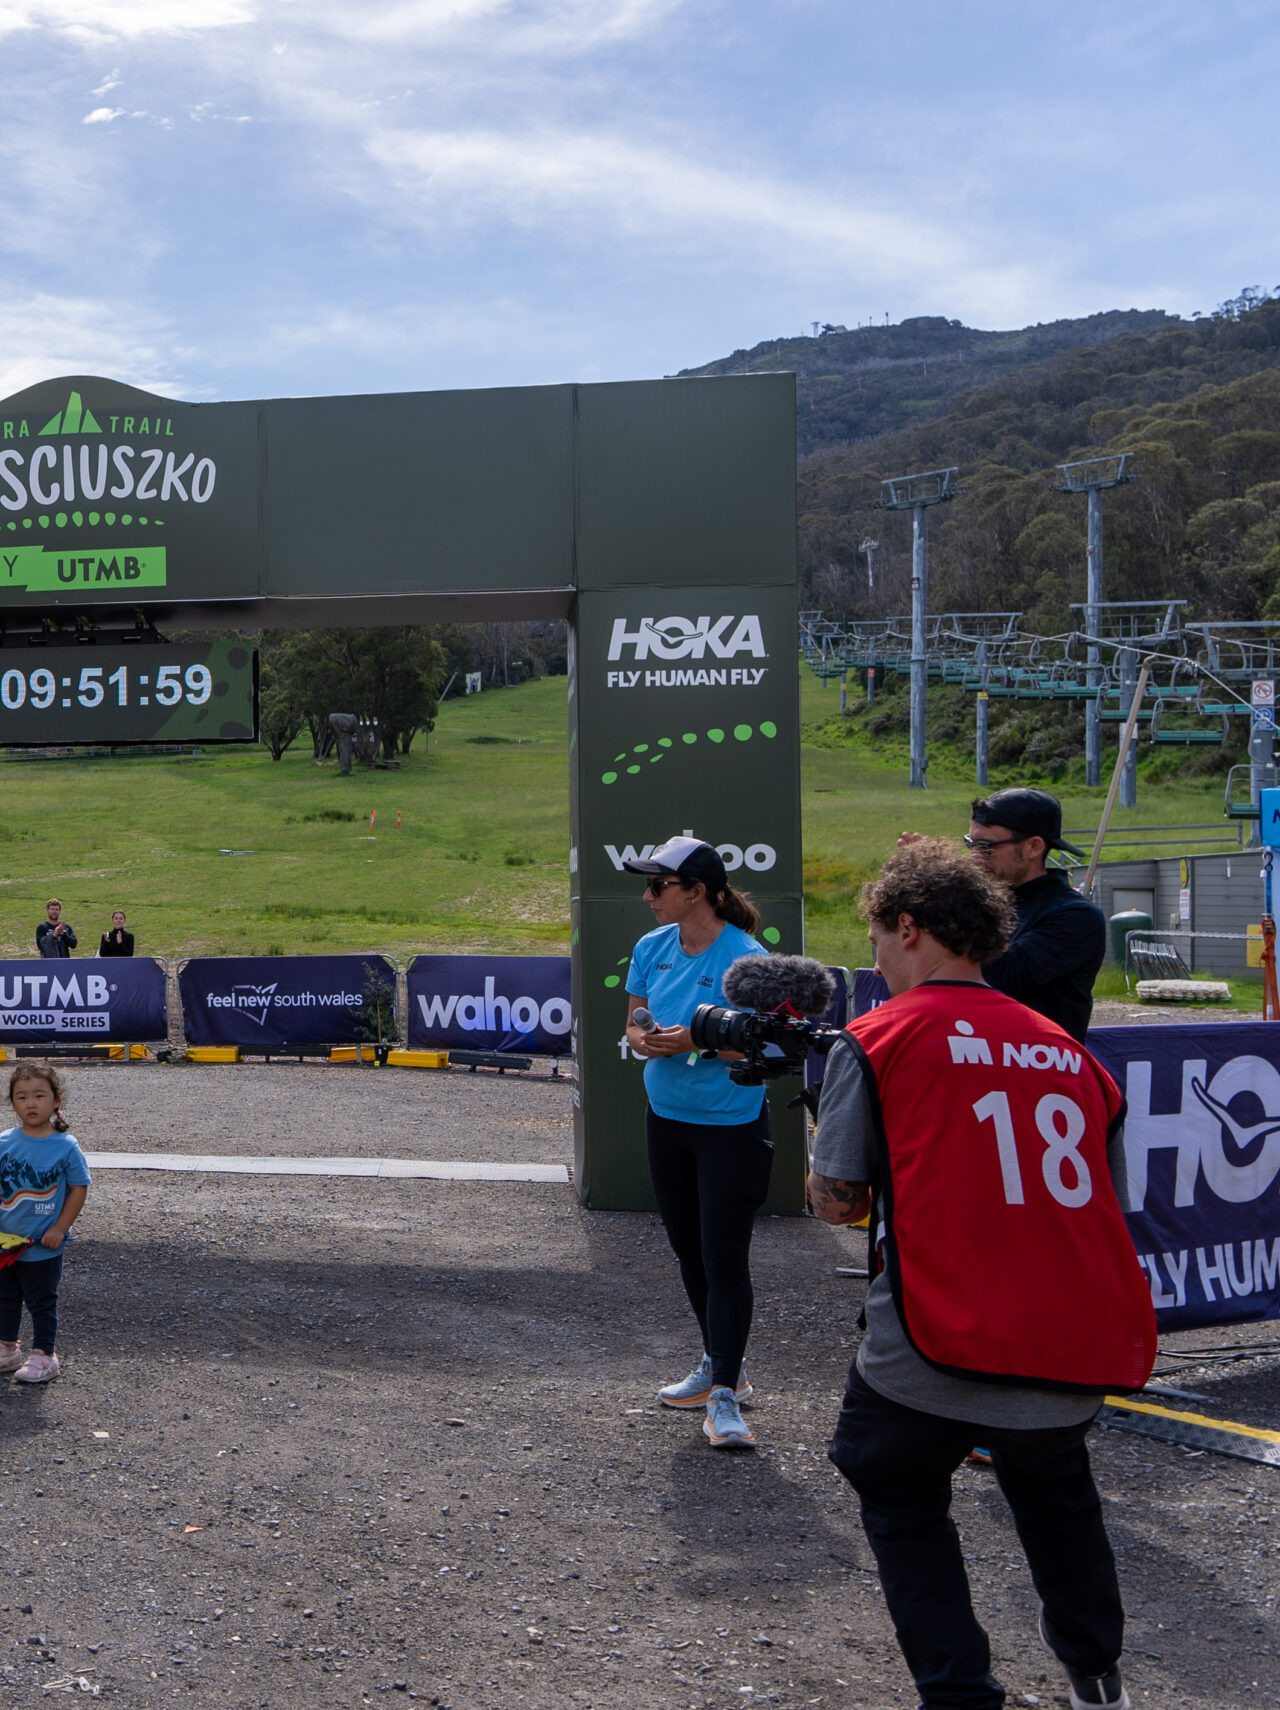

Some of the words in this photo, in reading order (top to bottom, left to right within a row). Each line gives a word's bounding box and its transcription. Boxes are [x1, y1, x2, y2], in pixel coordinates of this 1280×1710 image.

[110, 416, 174, 436] TRAIL
[607, 615, 766, 661] HOKA
[1, 664, 213, 709] 09:51:59
[607, 670, 641, 688] FLY
[645, 668, 726, 687] HUMAN
[731, 668, 765, 685] FLY
[604, 830, 776, 872] woo
[2, 1013, 55, 1026] WORLD
[61, 1016, 105, 1028] SERIES
[206, 992, 235, 1008] feel
[238, 996, 270, 1007] new
[274, 991, 316, 1007] south
[318, 990, 363, 1006] wales
[417, 976, 571, 1035] wahoo
[1003, 1042, 1082, 1075] NOW
[972, 1091, 1093, 1208] 18
[1123, 1055, 1280, 1212] HO
[1196, 1237, 1280, 1302] HUM
